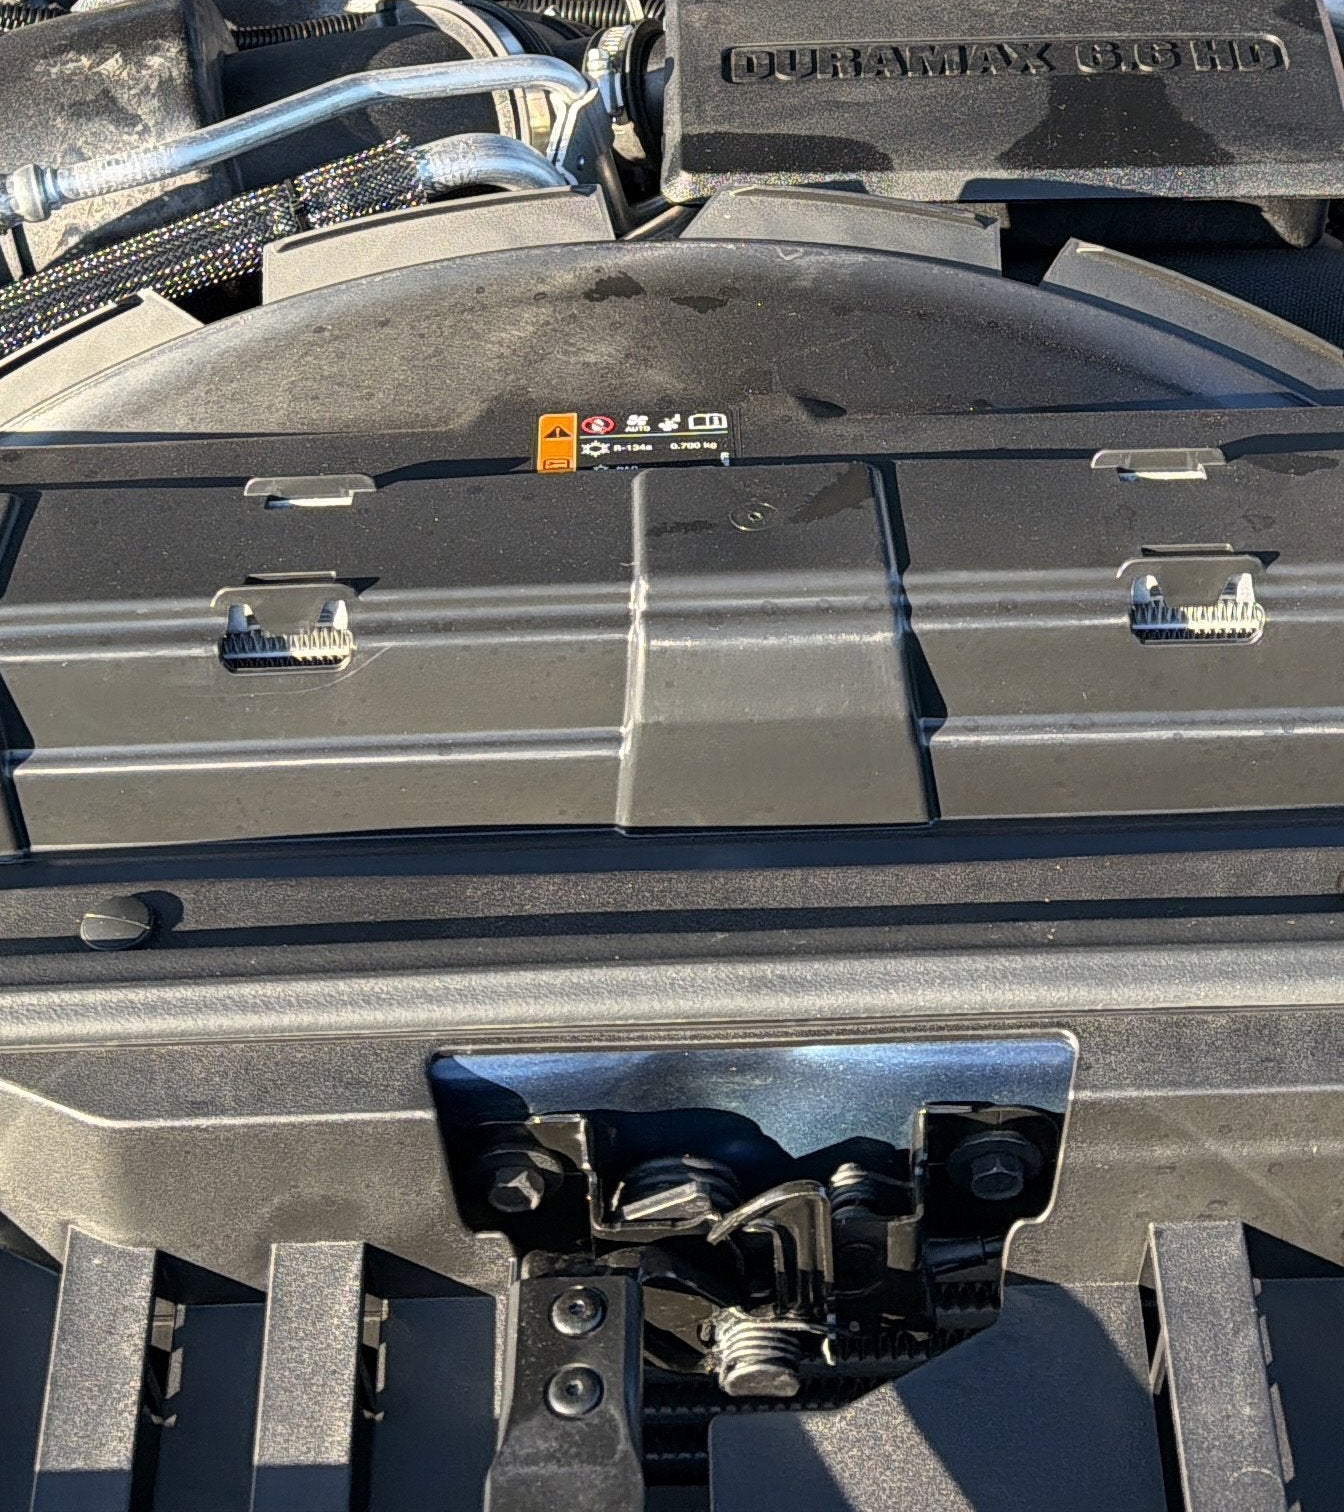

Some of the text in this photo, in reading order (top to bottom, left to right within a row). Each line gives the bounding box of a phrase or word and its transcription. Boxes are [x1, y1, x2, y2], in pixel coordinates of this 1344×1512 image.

[726, 38, 1288, 83] DURAMAX 6.6 HD
[625, 425, 651, 433] AUTO
[613, 444, 653, 452] R-134a
[669, 441, 701, 450] 0.700
